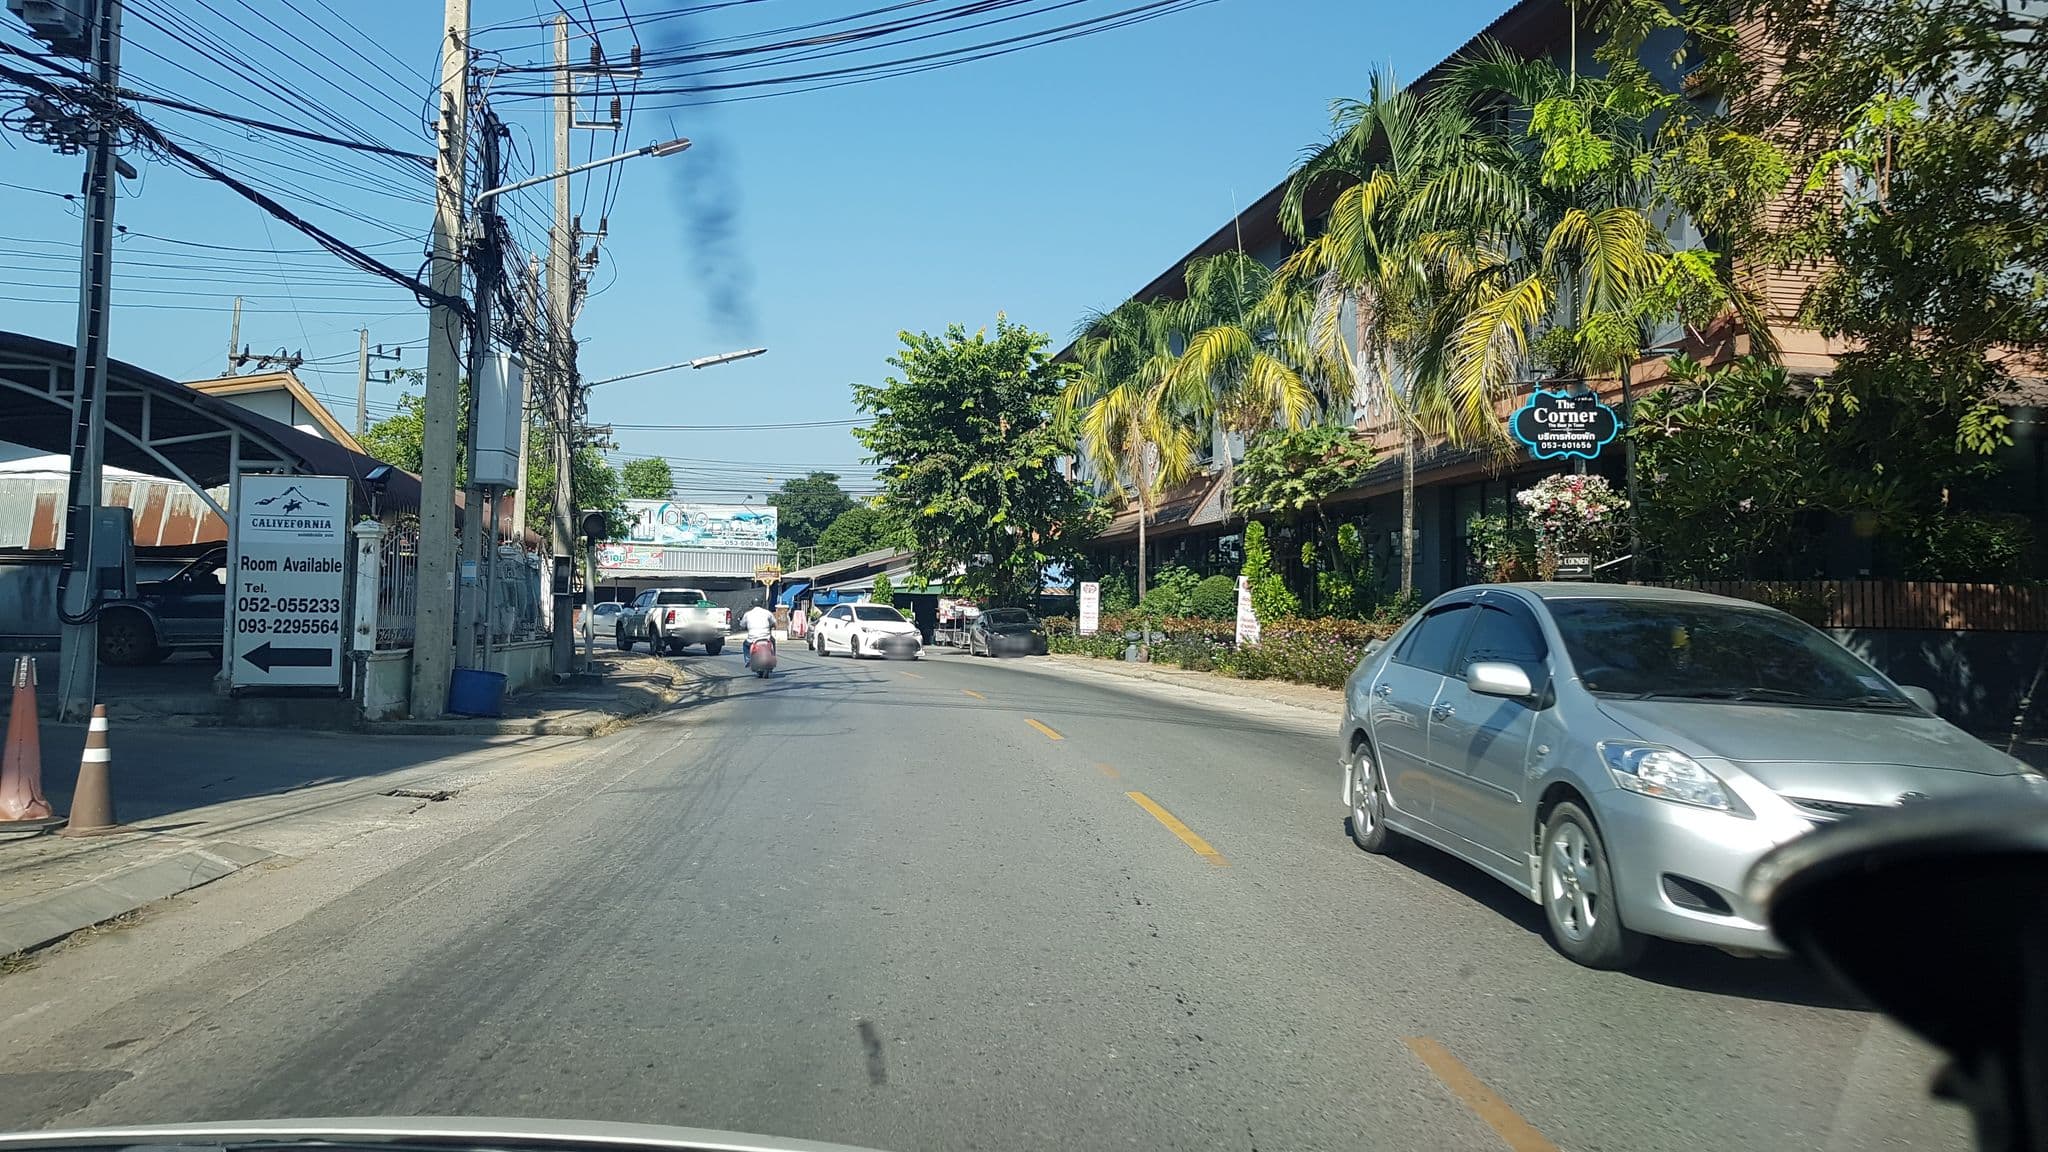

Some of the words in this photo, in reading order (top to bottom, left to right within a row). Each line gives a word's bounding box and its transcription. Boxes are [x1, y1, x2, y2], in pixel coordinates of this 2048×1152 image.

[1555, 399, 1576, 409] The
[1533, 407, 1598, 423] Corner
[1537, 431, 1596, 441] บริการห้องพัก
[1541, 441, 1592, 449] 053-601656
[251, 518, 332, 529] CALIVEFORNIA
[240, 555, 278, 572] Room
[283, 557, 343, 573] Available
[244, 582, 268, 593] Tel.
[238, 597, 340, 613] 052-055233
[238, 618, 339, 634] 093-2295564
